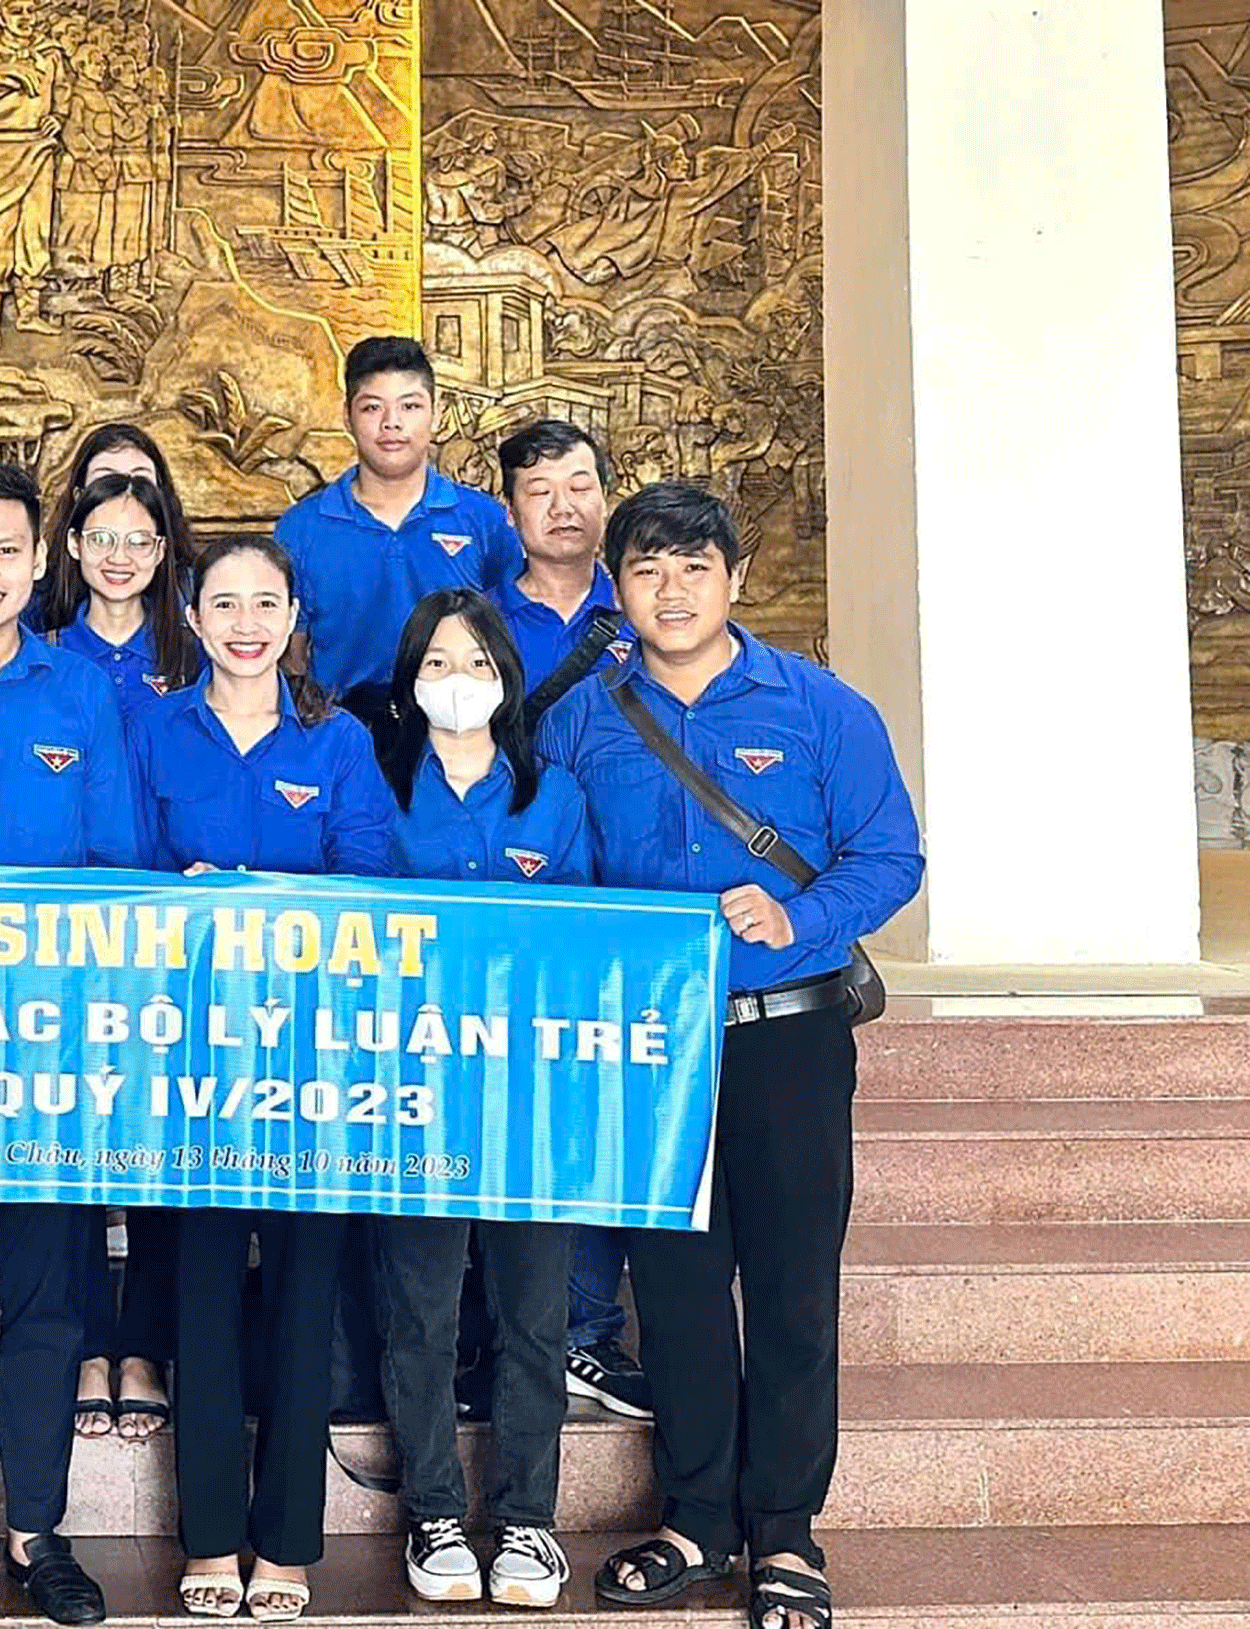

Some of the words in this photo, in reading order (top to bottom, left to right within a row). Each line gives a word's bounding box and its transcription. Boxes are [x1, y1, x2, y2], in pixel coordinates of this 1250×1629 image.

[213, 907, 438, 988] HOẠT
[87, 994, 183, 1054] BỘ
[208, 998, 291, 1048] LÝ
[315, 1004, 509, 1064] LUẬN
[532, 1010, 669, 1065] TRẺ
[150, 1076, 434, 1127] IV/2023
[6, 1140, 87, 1167] Châu,
[96, 1147, 165, 1172] ngày
[173, 1146, 203, 1167] 13
[211, 1147, 291, 1177] tháng
[300, 1150, 329, 1172] 10
[338, 1151, 397, 1174] năm
[404, 1153, 470, 1177] 2023
